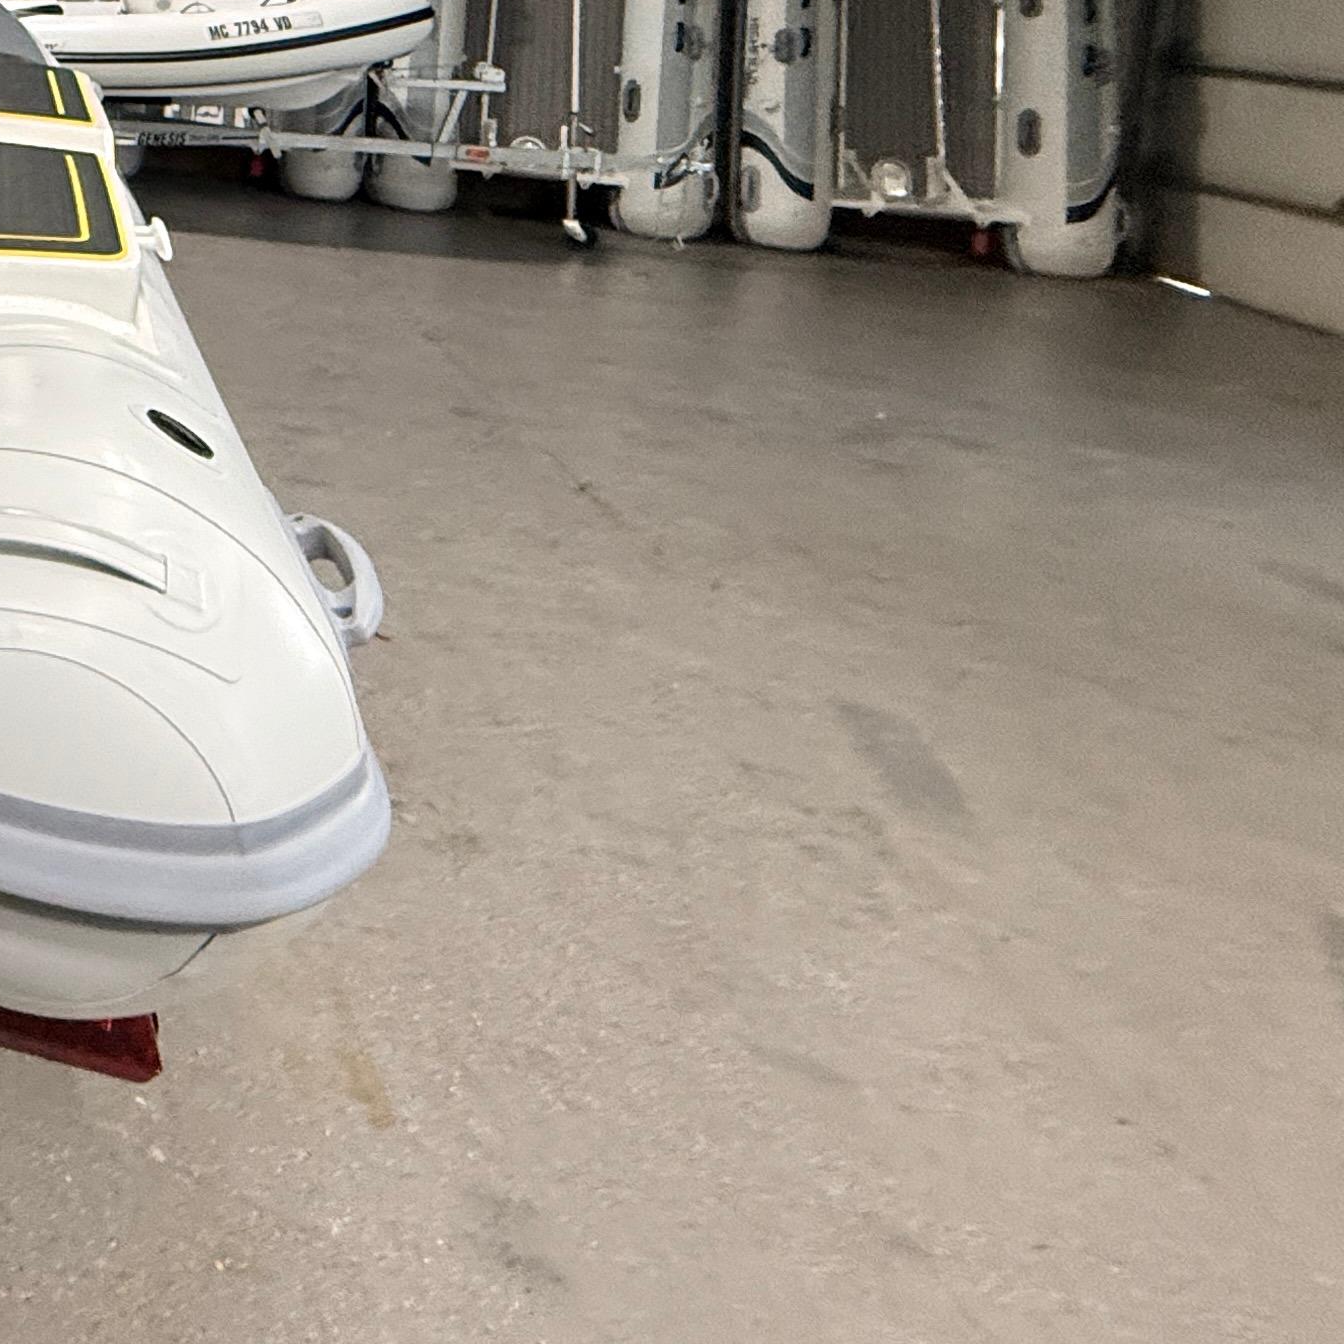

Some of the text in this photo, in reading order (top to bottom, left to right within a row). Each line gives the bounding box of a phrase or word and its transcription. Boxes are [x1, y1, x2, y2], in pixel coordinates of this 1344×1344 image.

[208, 16, 292, 40] MC 7794 VD
[137, 131, 187, 146] GENESIS
